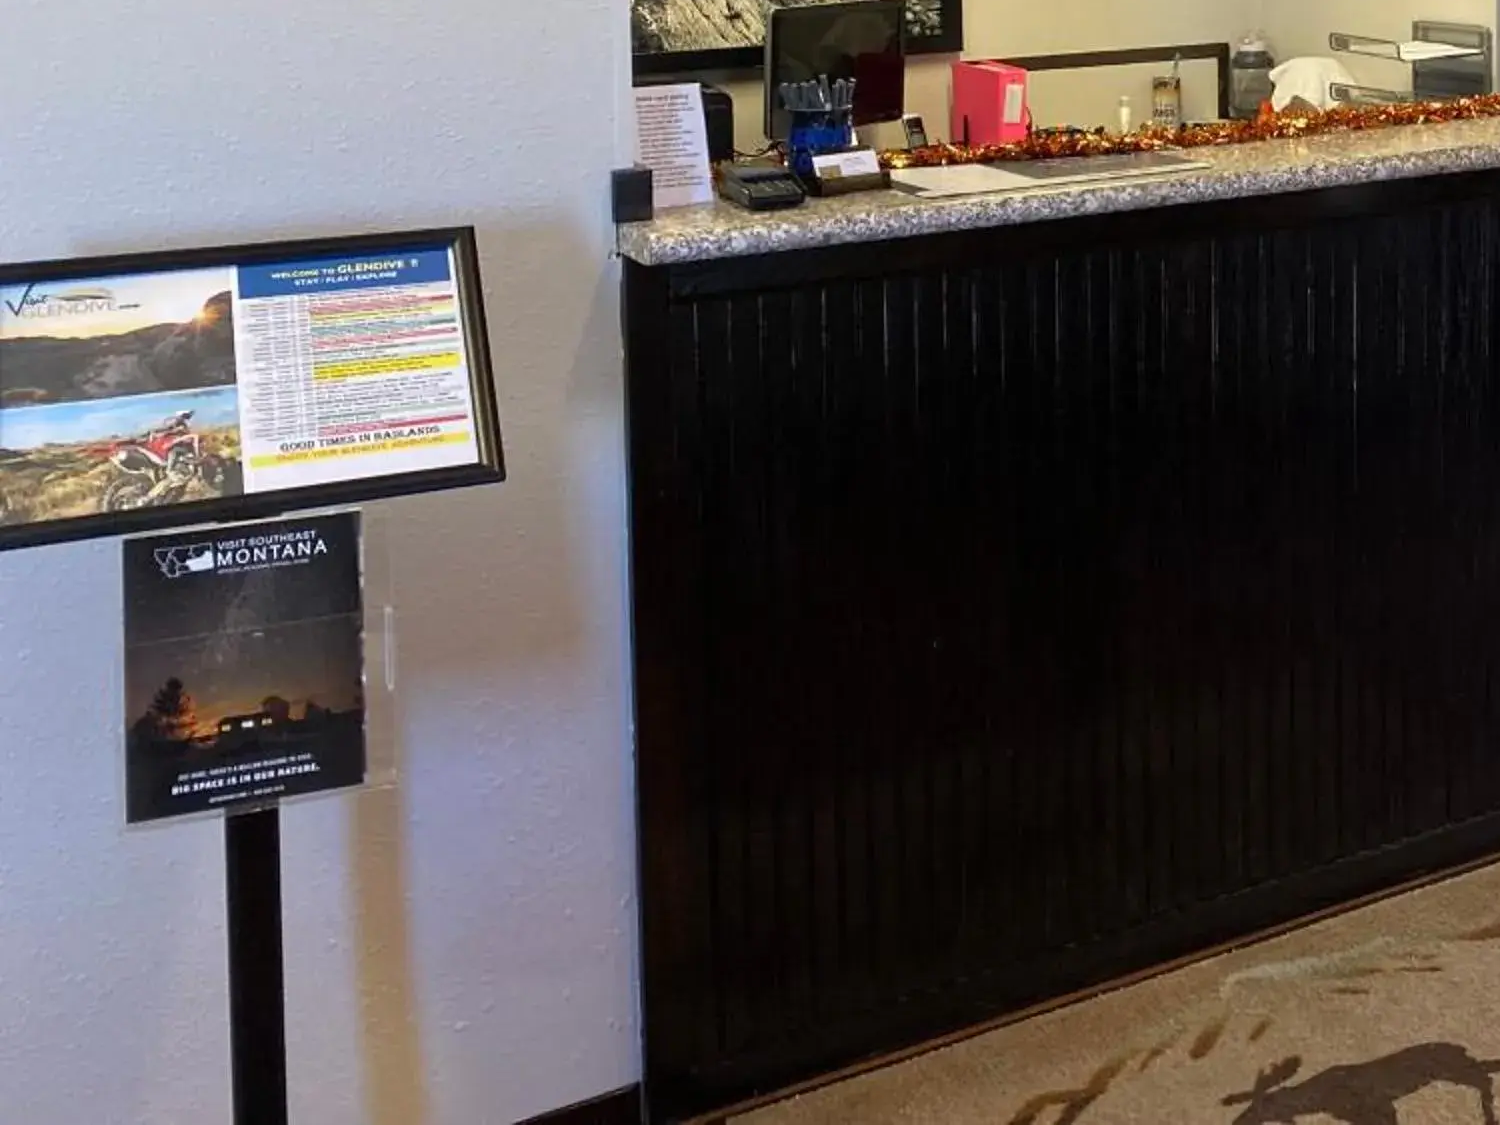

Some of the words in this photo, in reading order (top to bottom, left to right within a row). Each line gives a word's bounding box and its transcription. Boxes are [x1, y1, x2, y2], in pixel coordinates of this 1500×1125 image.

[271, 269, 319, 280] WELCOME
[337, 258, 405, 275] GLENDIVE
[279, 439, 316, 452] GOOD
[319, 435, 357, 449] TIMES
[359, 431, 372, 442] IN
[217, 537, 247, 551] VISIT
[248, 530, 316, 546] SOUTHEAST
[217, 539, 328, 567] MONTANA
